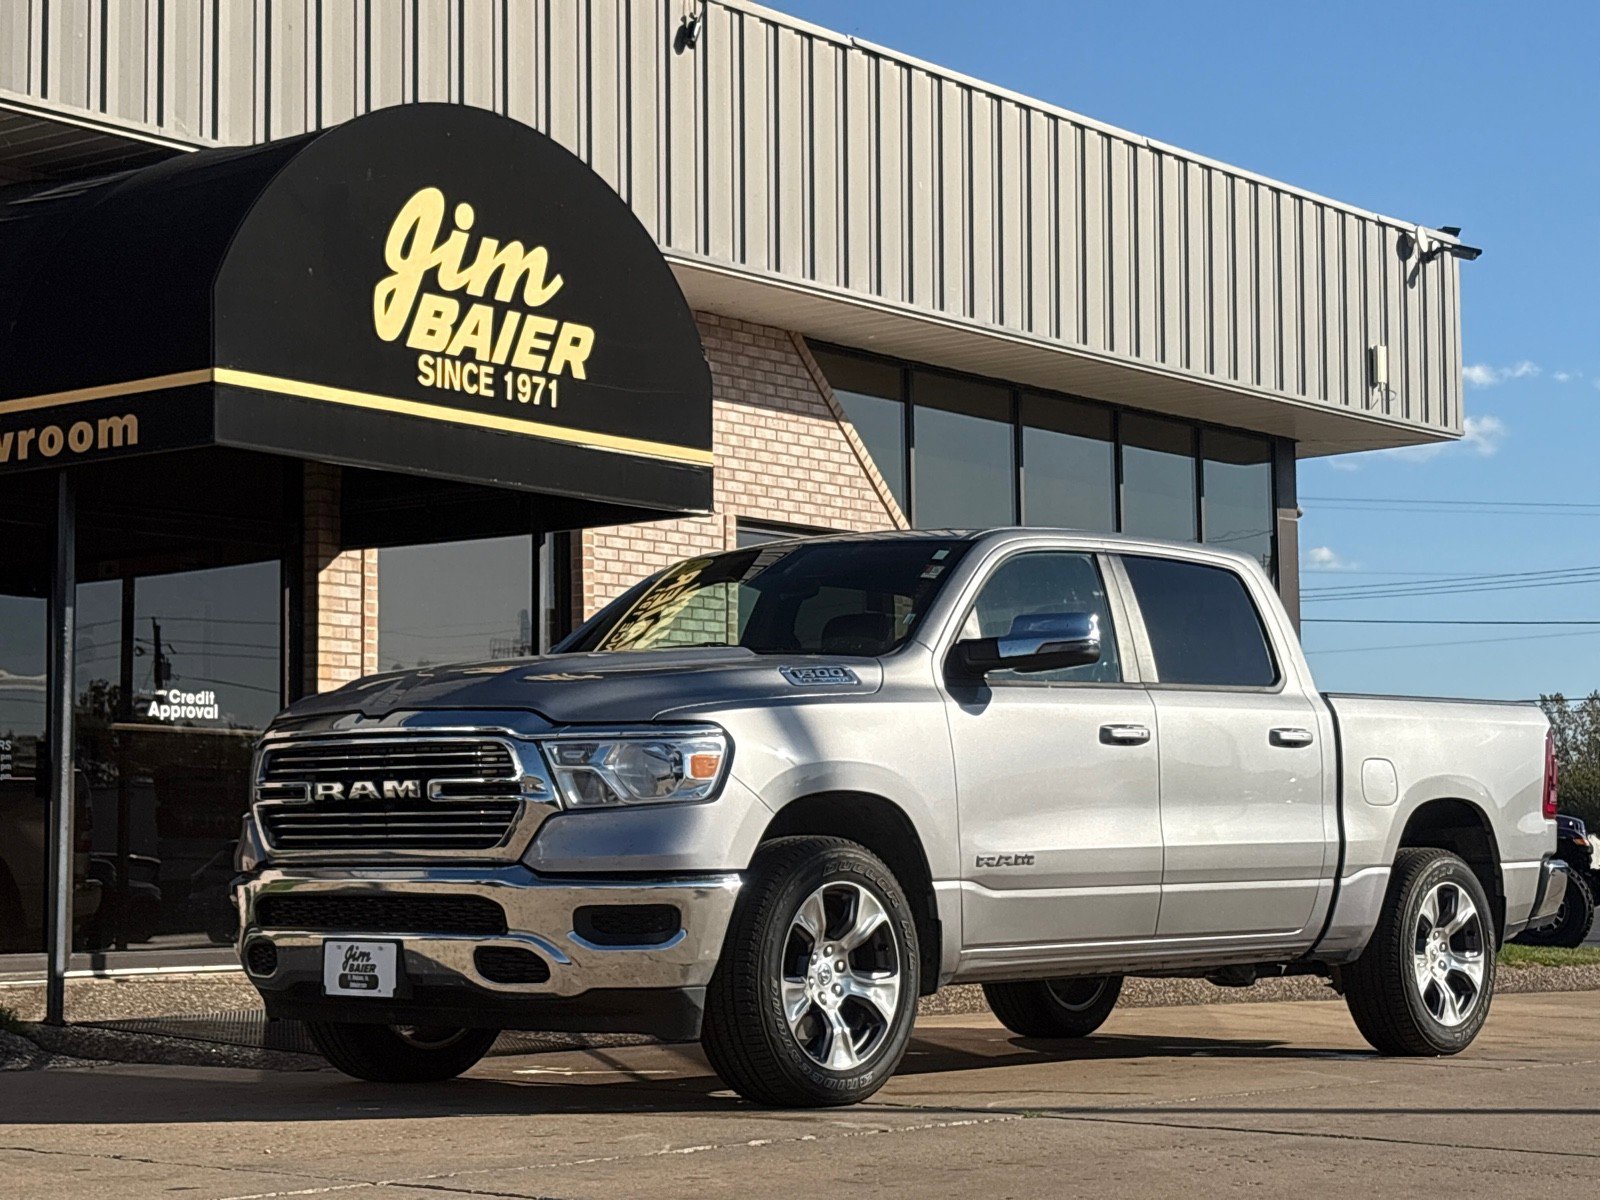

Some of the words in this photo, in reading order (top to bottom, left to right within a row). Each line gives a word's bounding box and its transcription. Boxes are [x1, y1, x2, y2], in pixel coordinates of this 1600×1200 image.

[374, 187, 564, 342] Jim
[406, 293, 595, 380] BAIER
[417, 353, 495, 398] SINCE
[504, 371, 557, 408] 1971
[169, 689, 215, 705] Credit
[148, 701, 219, 721] Approval
[314, 780, 422, 801] RAM
[342, 944, 372, 972] Jim
[348, 963, 377, 973] BAIER
